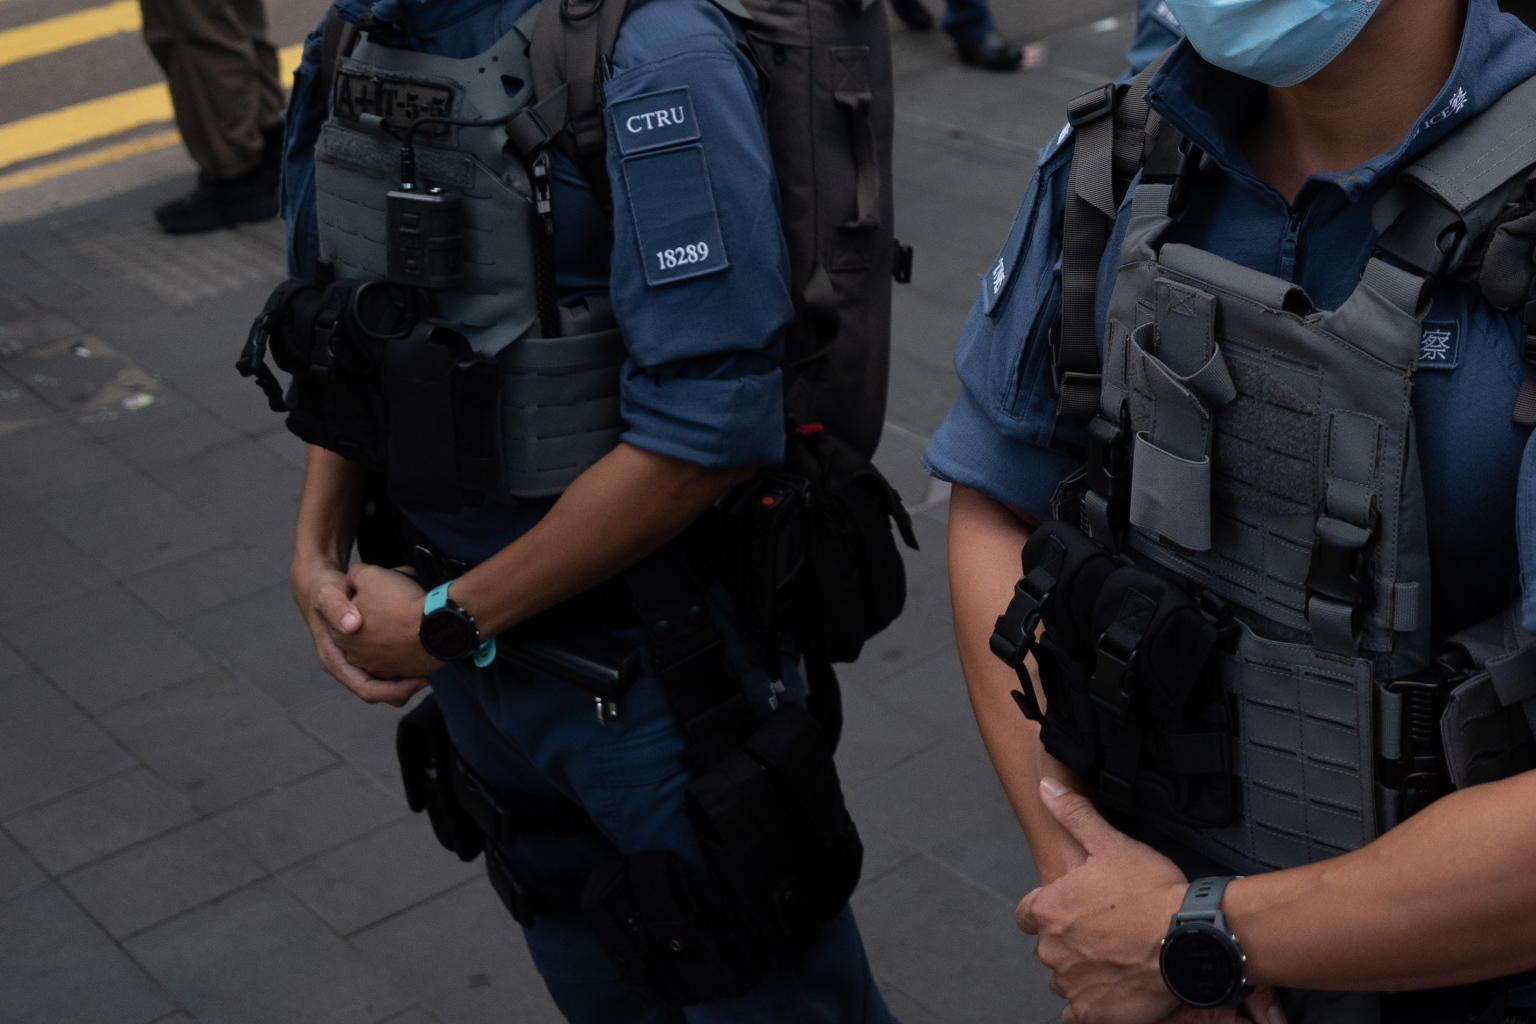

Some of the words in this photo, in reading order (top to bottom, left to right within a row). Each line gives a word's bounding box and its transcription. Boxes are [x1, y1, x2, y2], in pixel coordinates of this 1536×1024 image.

[626, 106, 686, 133] CTRU
[656, 242, 709, 270] 18289
[1419, 329, 1451, 360] 察
